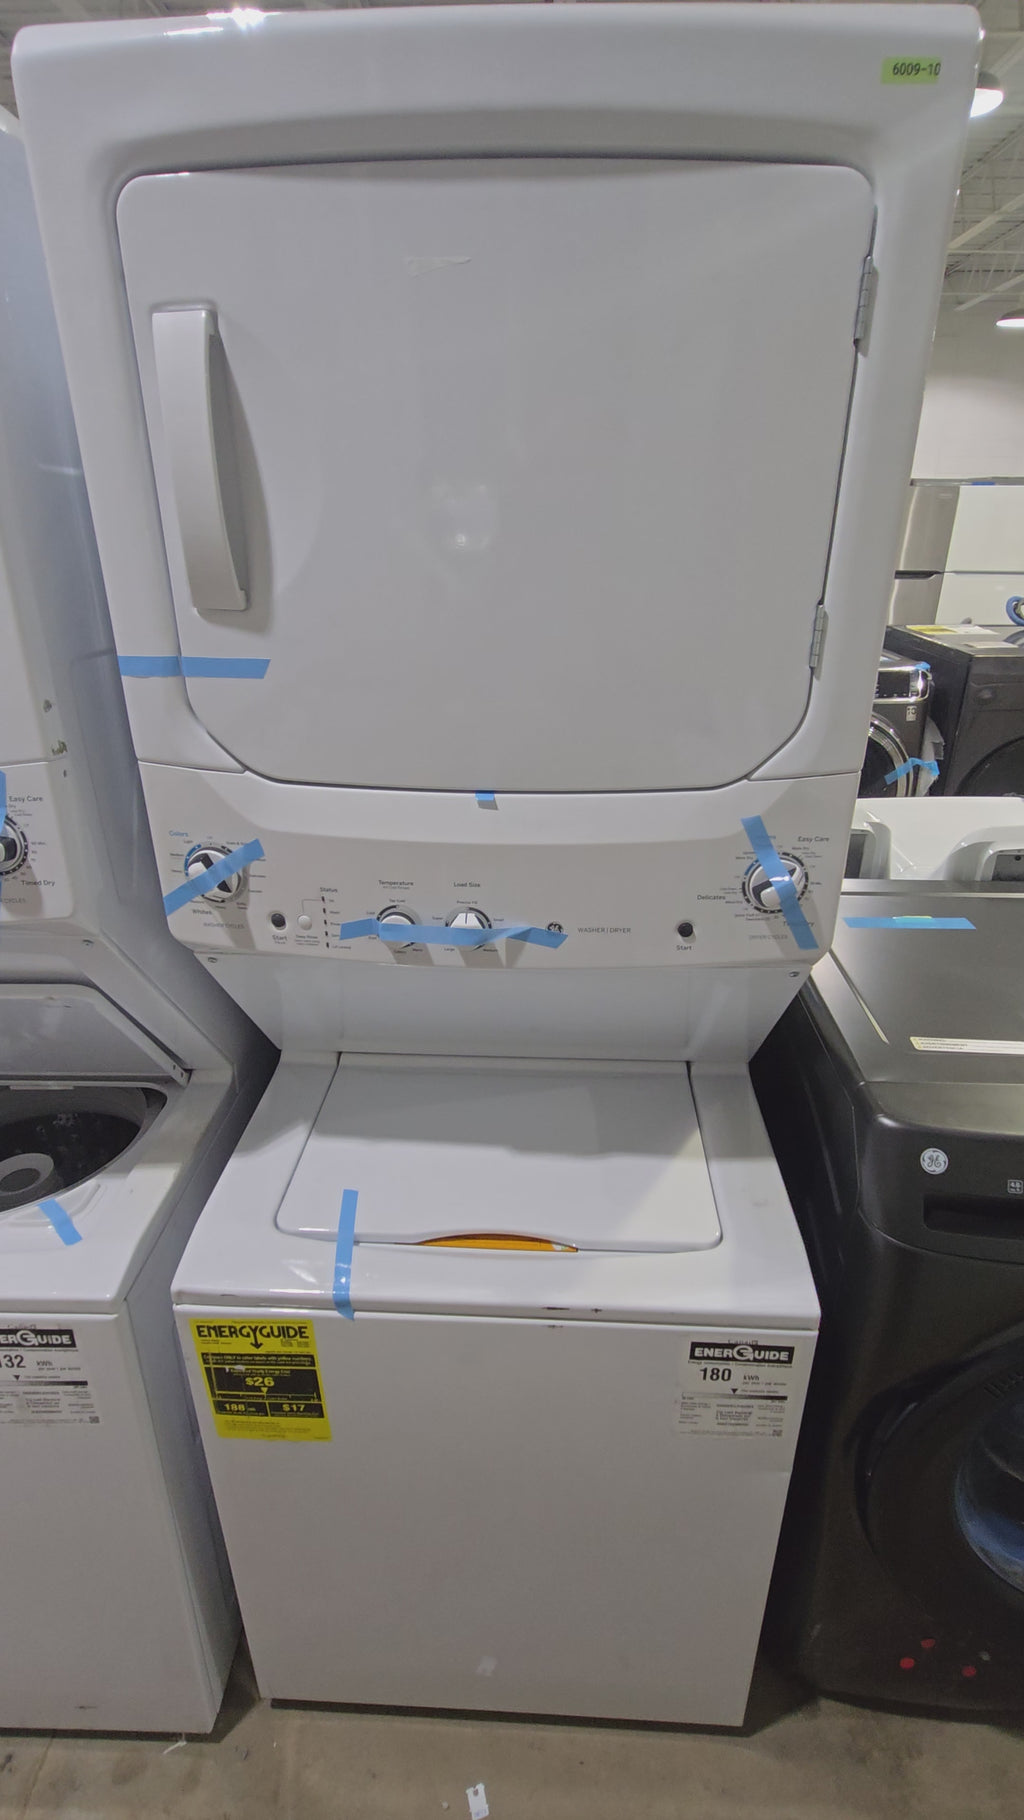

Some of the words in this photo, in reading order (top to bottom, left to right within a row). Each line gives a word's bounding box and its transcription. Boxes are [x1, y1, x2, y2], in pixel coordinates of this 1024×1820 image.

[892, 62, 942, 76] 6009-10
[9, 795, 25, 803] Easy
[196, 1324, 310, 1342] ENERGYGUIDE
[694, 1345, 789, 1361] ENERGUIDE
[700, 1367, 732, 1381] 180
[245, 1376, 275, 1387] $26
[224, 1403, 245, 1412] 188
[282, 1404, 306, 1412] $17
